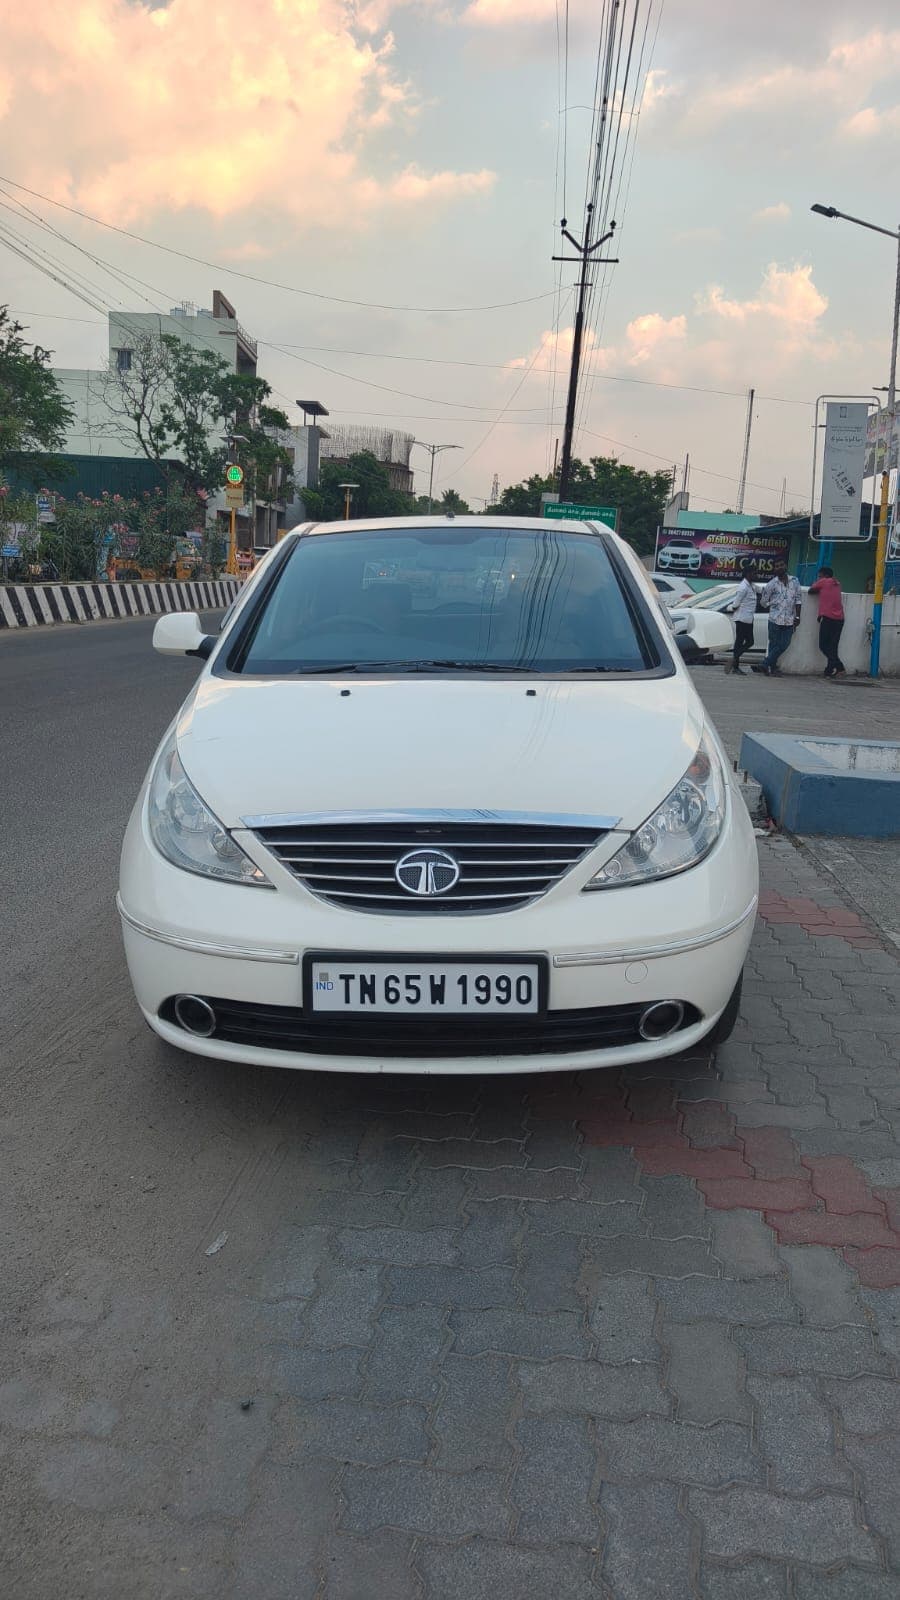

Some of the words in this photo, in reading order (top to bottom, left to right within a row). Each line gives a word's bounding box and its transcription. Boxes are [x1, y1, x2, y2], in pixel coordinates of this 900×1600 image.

[716, 556, 736, 569] SM
[740, 557, 773, 571] CARS
[315, 981, 334, 991] IND
[338, 973, 376, 1005] TN
[384, 974, 421, 1005] 65
[429, 974, 446, 1005] W
[457, 974, 532, 1005] 1990
